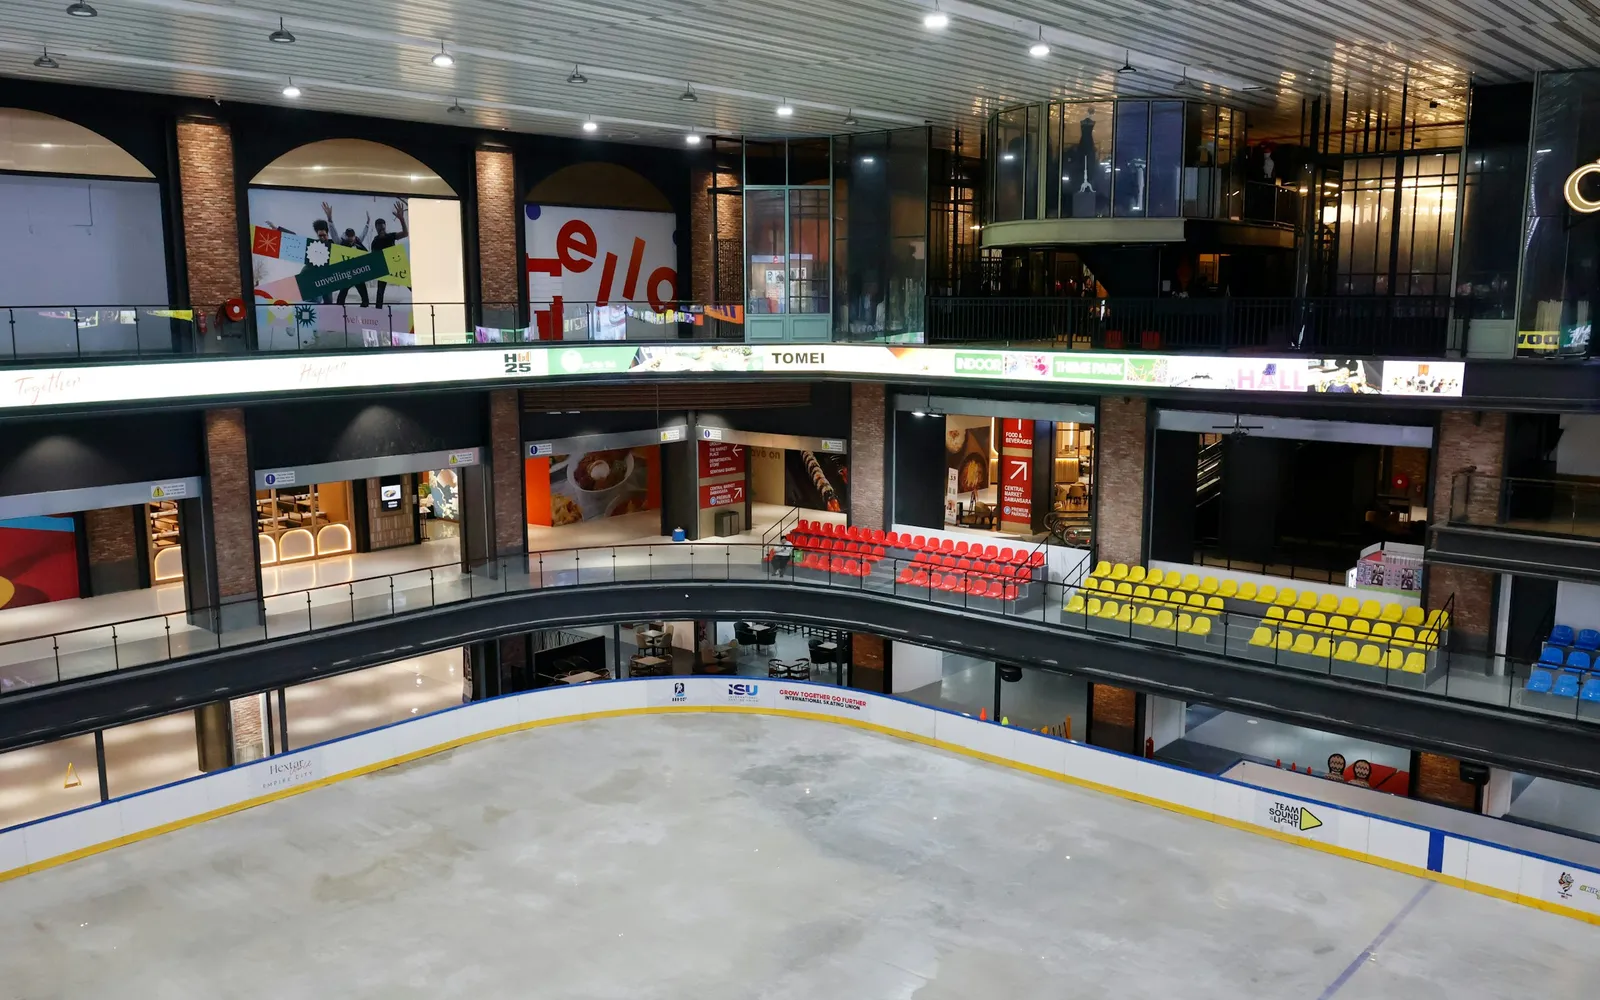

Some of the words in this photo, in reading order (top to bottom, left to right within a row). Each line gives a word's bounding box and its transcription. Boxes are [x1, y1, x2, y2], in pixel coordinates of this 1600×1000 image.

[314, 270, 352, 288] unveiling
[353, 264, 371, 276] soon
[771, 352, 825, 364] TOMEI
[504, 363, 531, 373] 25
[1006, 438, 1032, 446] BEVERAGES
[1004, 485, 1024, 493] CENTRAL
[1004, 491, 1022, 499] MARKET
[728, 684, 759, 696] ISU
[785, 696, 823, 704] INTERNATIONAL
[823, 700, 844, 708] SKATING
[845, 703, 861, 711] UNION
[800, 692, 831, 701] TOGETHER
[842, 698, 867, 707] FURTHER
[269, 760, 304, 775] Hextar
[1275, 802, 1299, 814] TEAM
[1269, 808, 1299, 821] SOUND
